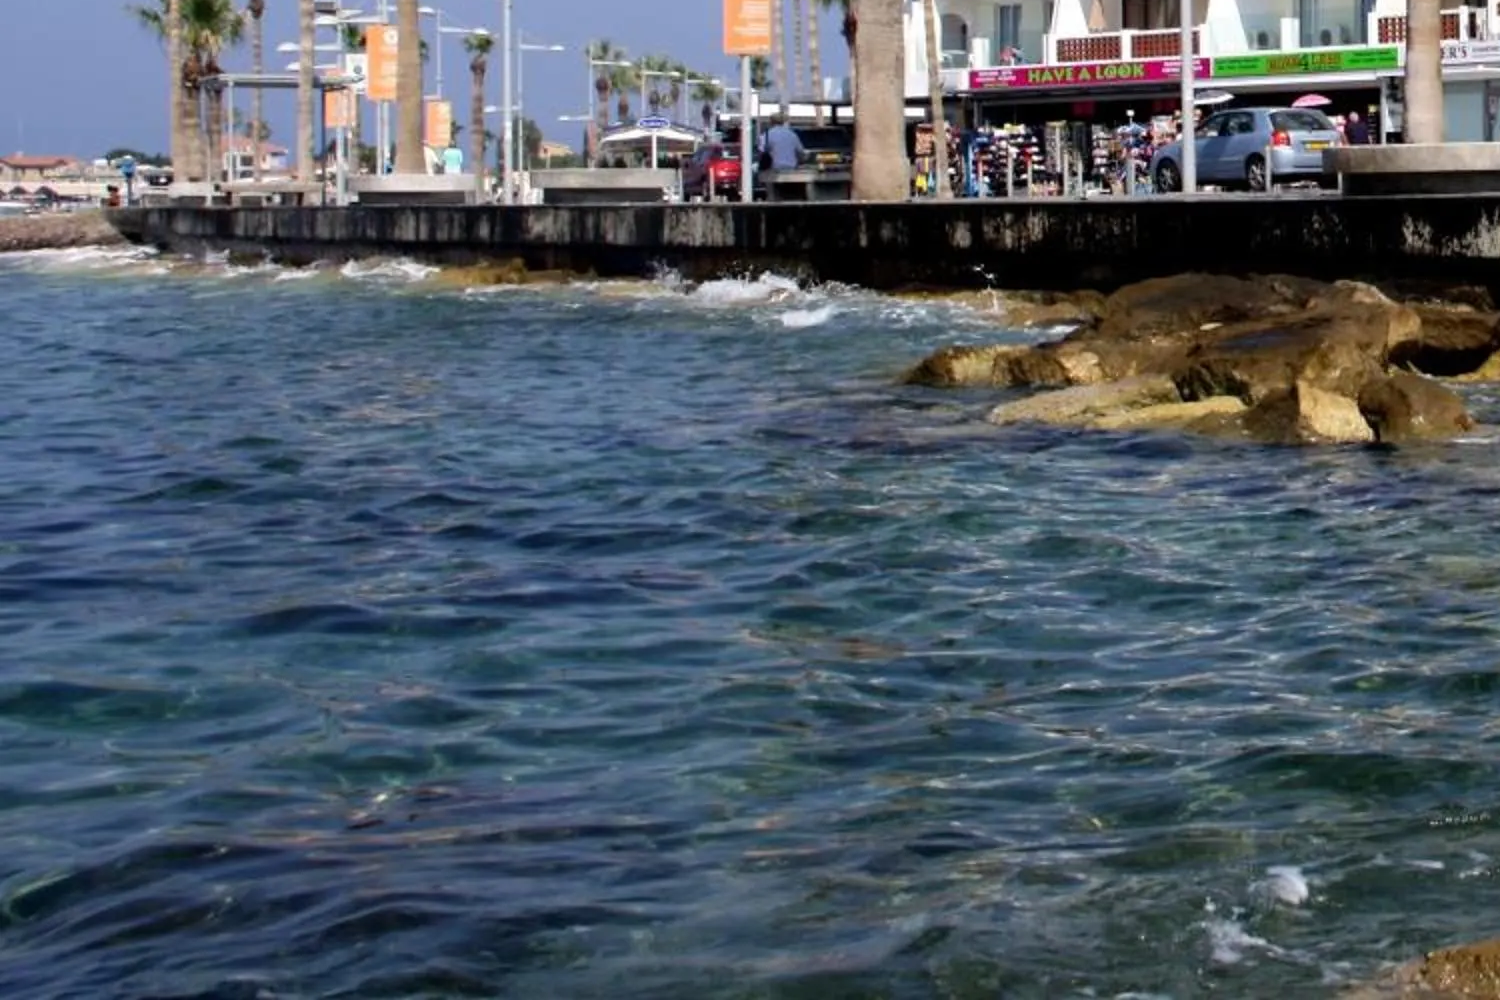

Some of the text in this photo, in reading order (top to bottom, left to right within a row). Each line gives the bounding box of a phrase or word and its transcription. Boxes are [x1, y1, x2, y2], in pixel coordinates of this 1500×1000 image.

[1028, 66, 1073, 83] HAVE
[1079, 66, 1091, 81] A
[1096, 63, 1144, 80] LOOK
